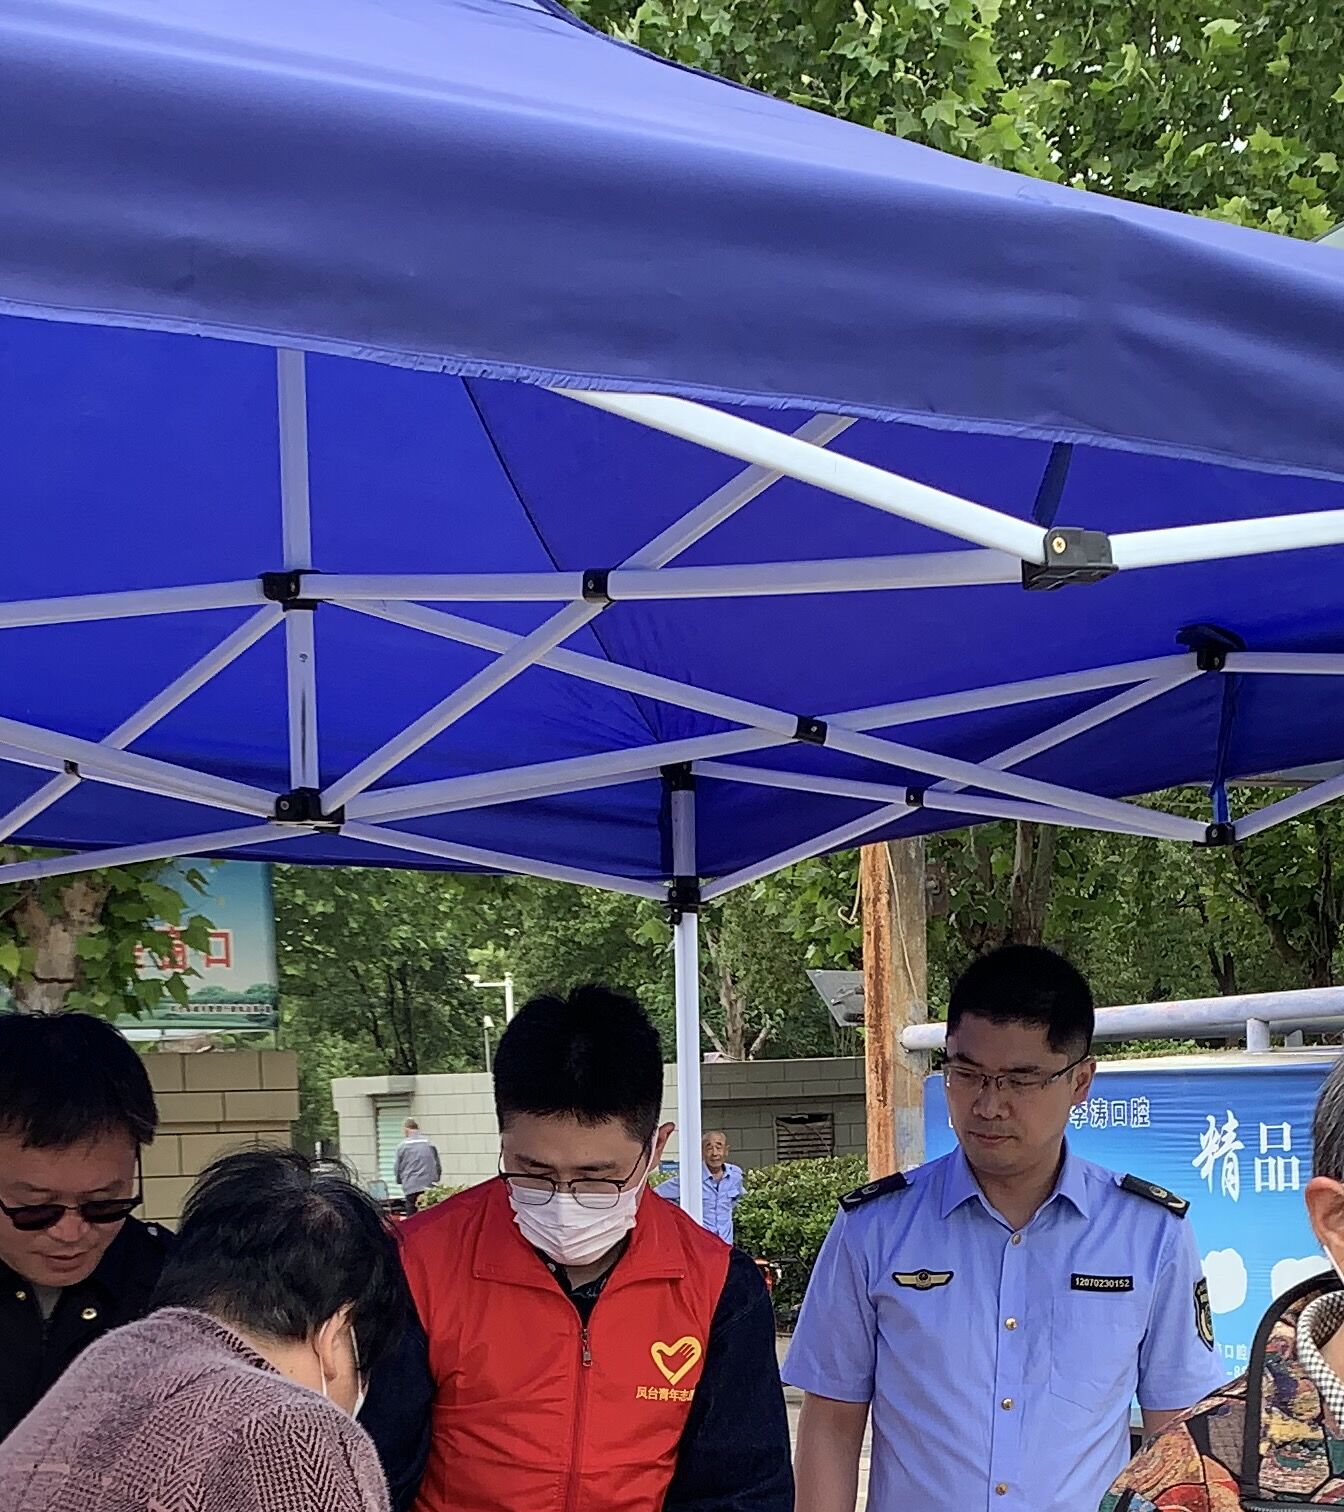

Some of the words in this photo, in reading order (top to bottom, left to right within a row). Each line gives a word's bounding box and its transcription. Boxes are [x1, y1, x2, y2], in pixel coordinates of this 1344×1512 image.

[1069, 1096, 1151, 1130] 李涛口腔
[1191, 1109, 1301, 1203] 精品
